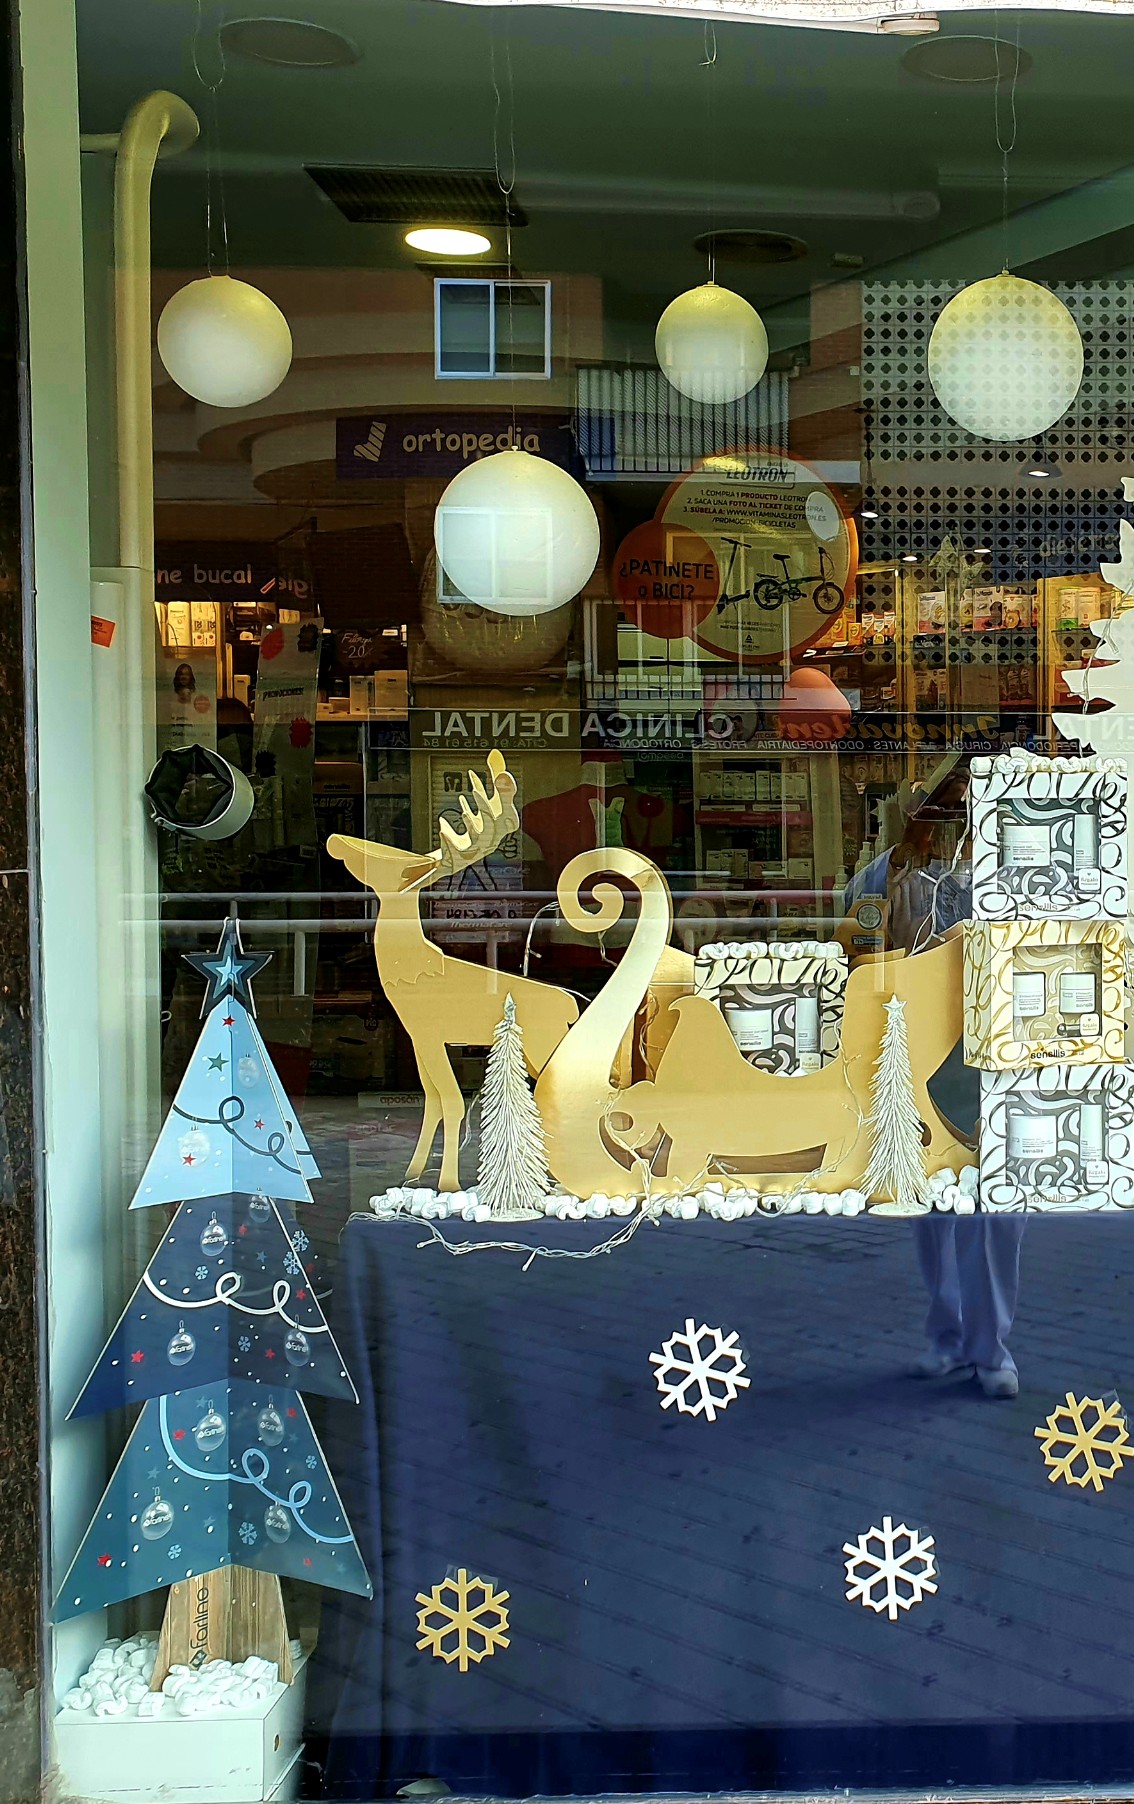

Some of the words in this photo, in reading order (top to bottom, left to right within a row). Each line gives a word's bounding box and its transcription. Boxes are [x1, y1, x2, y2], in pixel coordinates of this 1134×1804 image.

[403, 426, 540, 459] ortopedia
[706, 490, 735, 498] COMPRA
[740, 492, 778, 501] PRODUCTO
[759, 502, 783, 510] TICKET
[194, 563, 251, 585] bucal
[619, 559, 714, 580] ¿PATINETE
[653, 582, 694, 600] BICI?
[190, 1586, 209, 1650] farline
